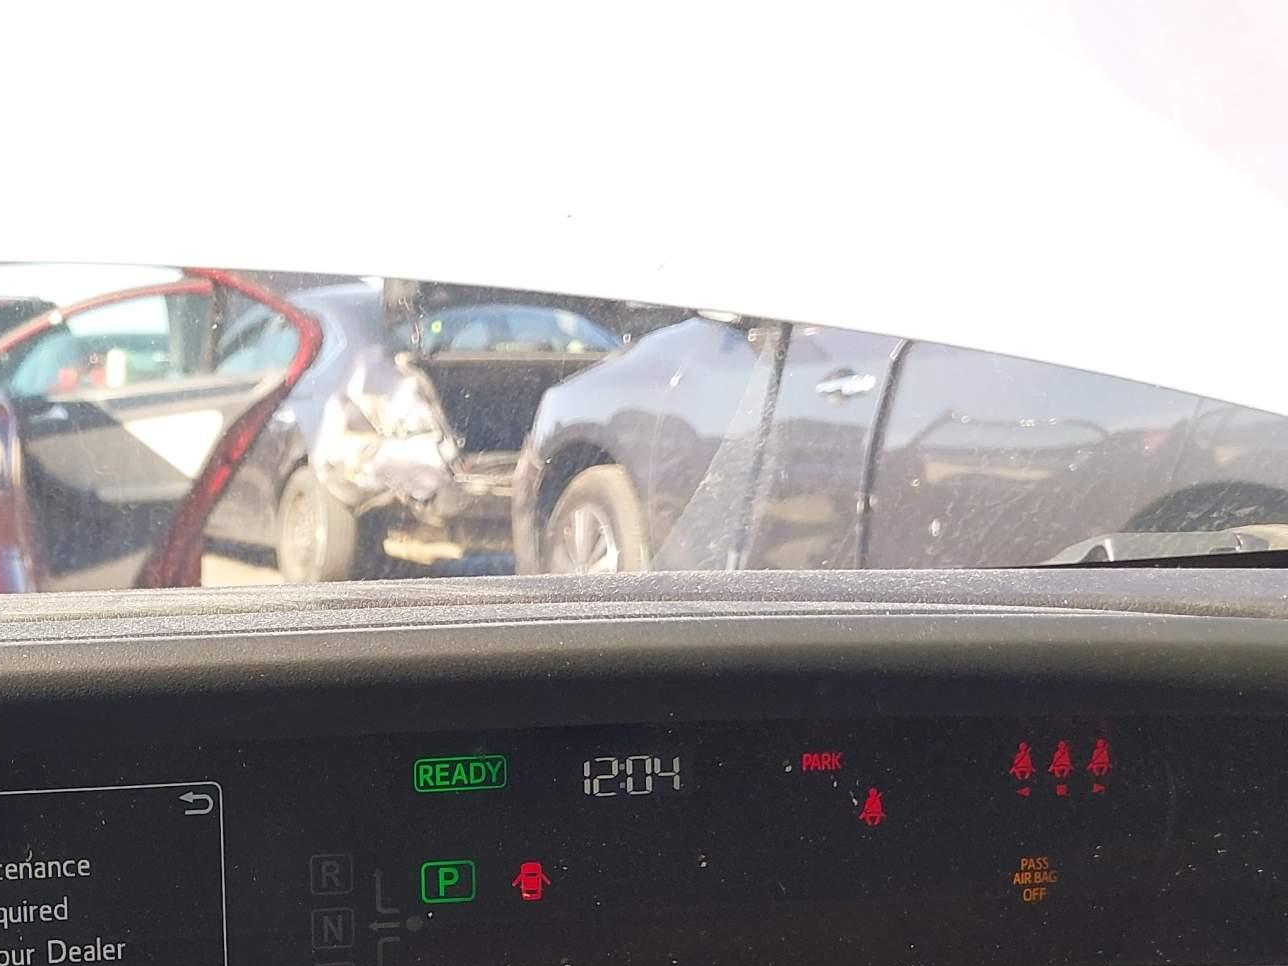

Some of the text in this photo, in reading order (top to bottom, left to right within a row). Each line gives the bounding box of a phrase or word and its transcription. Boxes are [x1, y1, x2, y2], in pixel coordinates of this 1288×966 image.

[418, 760, 502, 787] READY
[583, 755, 681, 796] 12:04
[802, 753, 842, 771] PARK
[321, 861, 342, 888] R
[1020, 857, 1050, 871] PASS
[437, 867, 459, 897] P
[1013, 871, 1032, 885] AIR
[1022, 887, 1048, 902] OFF
[322, 914, 343, 942] N
[47, 937, 127, 966] Dealer
